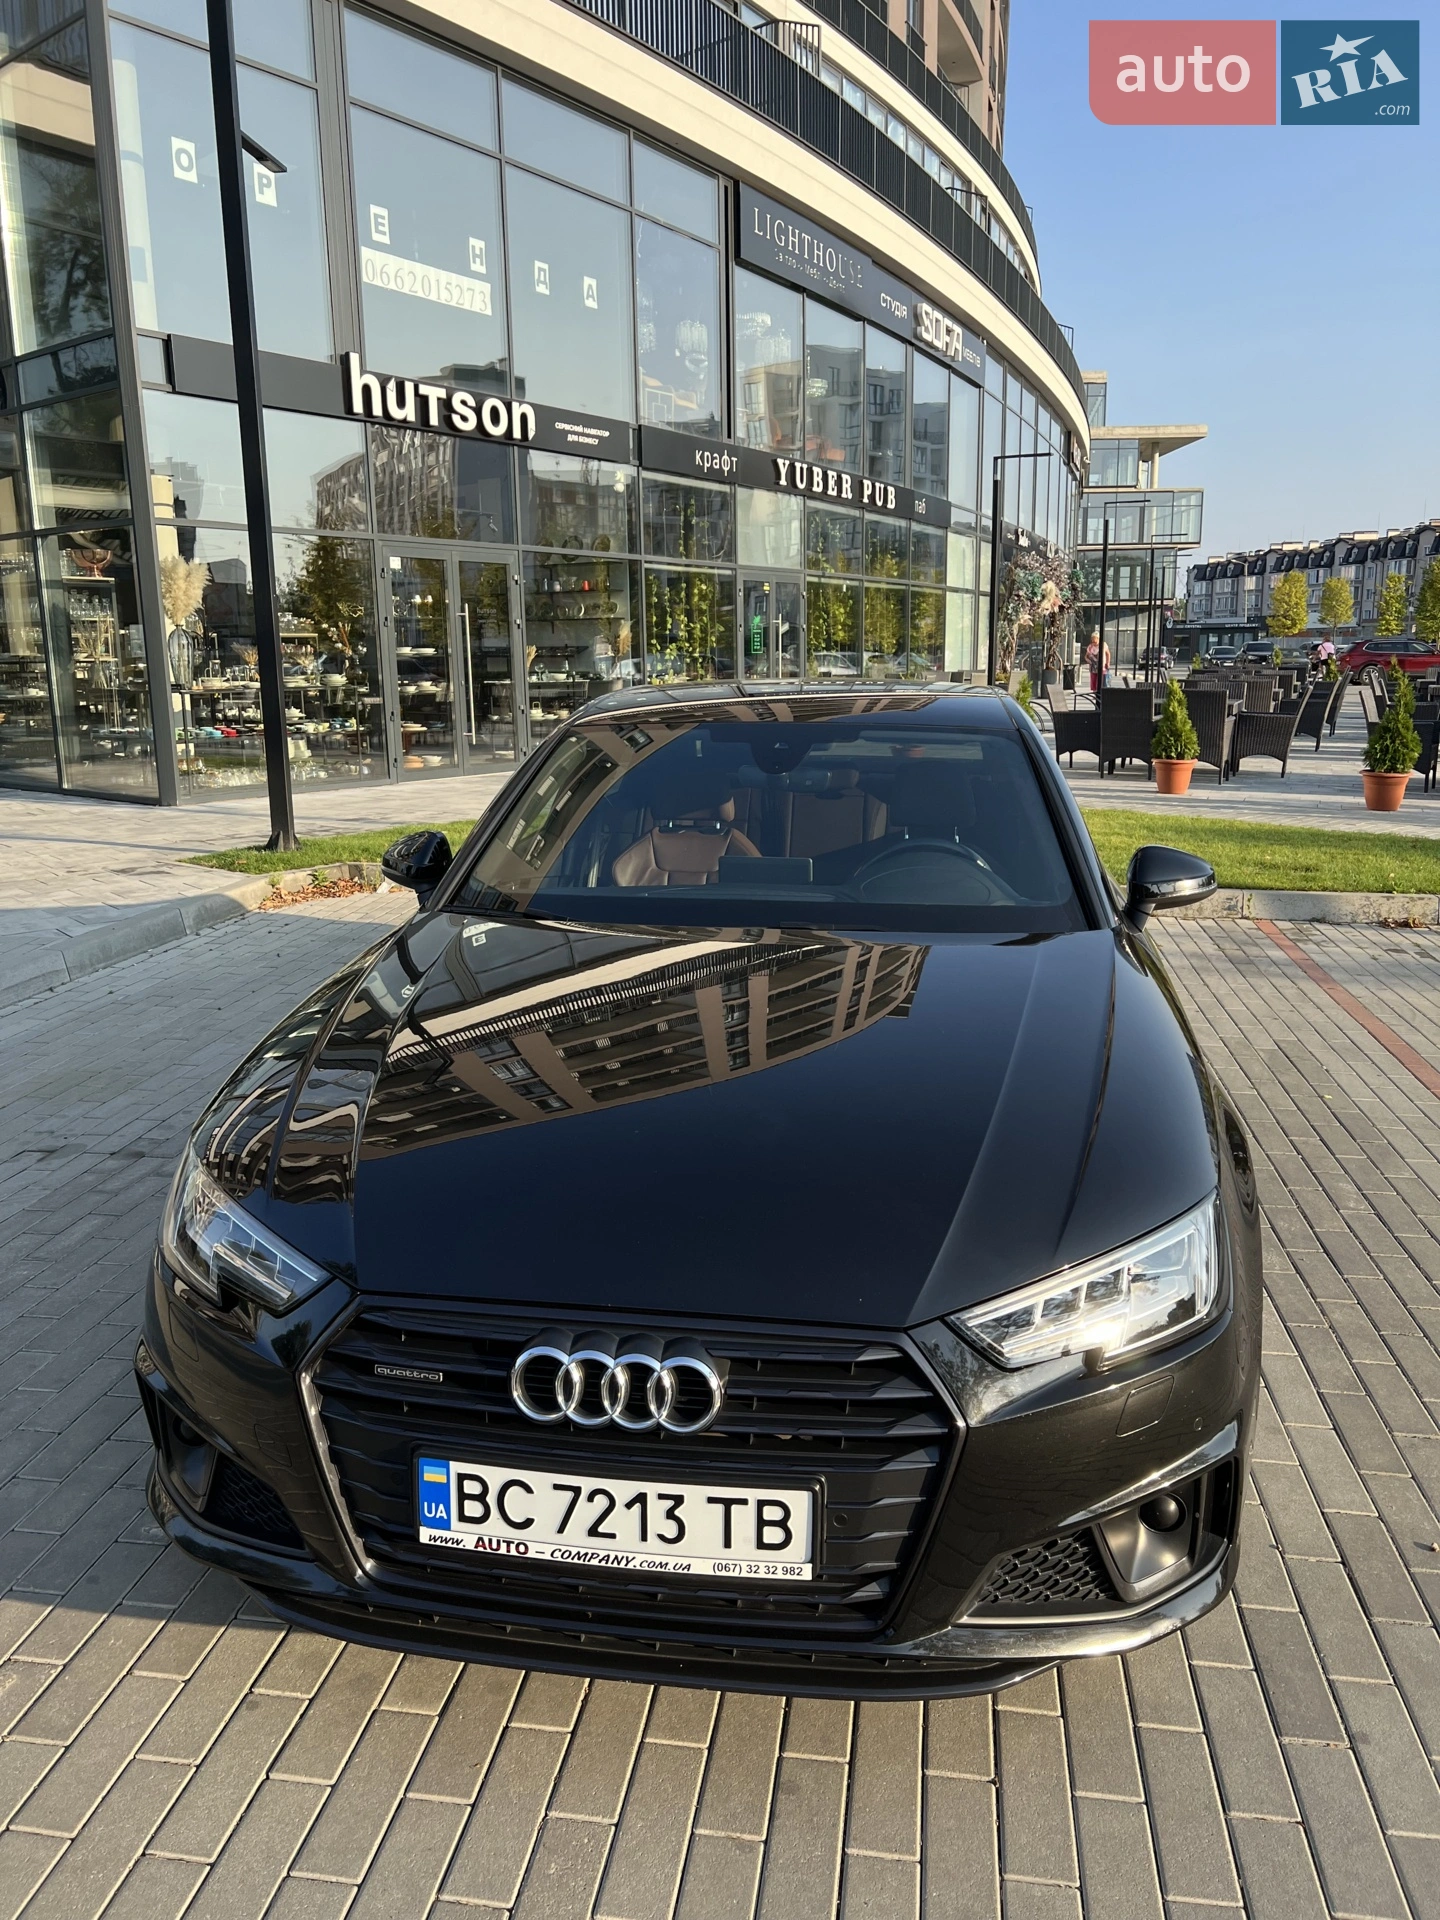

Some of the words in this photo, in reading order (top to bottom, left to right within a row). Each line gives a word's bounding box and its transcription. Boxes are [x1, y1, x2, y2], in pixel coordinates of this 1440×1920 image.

[754, 207, 863, 288] LIGHTHOUSE
[364, 258, 488, 313] 0662015273
[880, 292, 907, 319] СТУДІЯ
[918, 302, 962, 362] SOFA
[695, 449, 738, 476] крафт
[775, 457, 853, 500] YUBER
[861, 479, 897, 510] PUB
[914, 498, 927, 515] паб
[377, 1367, 439, 1380] quattro
[423, 1501, 448, 1520] UA
[456, 1472, 536, 1531] BC
[551, 1483, 687, 1545] 7213
[706, 1496, 793, 1551] TB
[473, 1536, 529, 1556] AUTO
[712, 1561, 743, 1575] (067)
[745, 1564, 761, 1574] 32
[763, 1565, 779, 1575] 32
[781, 1565, 804, 1577] 982
